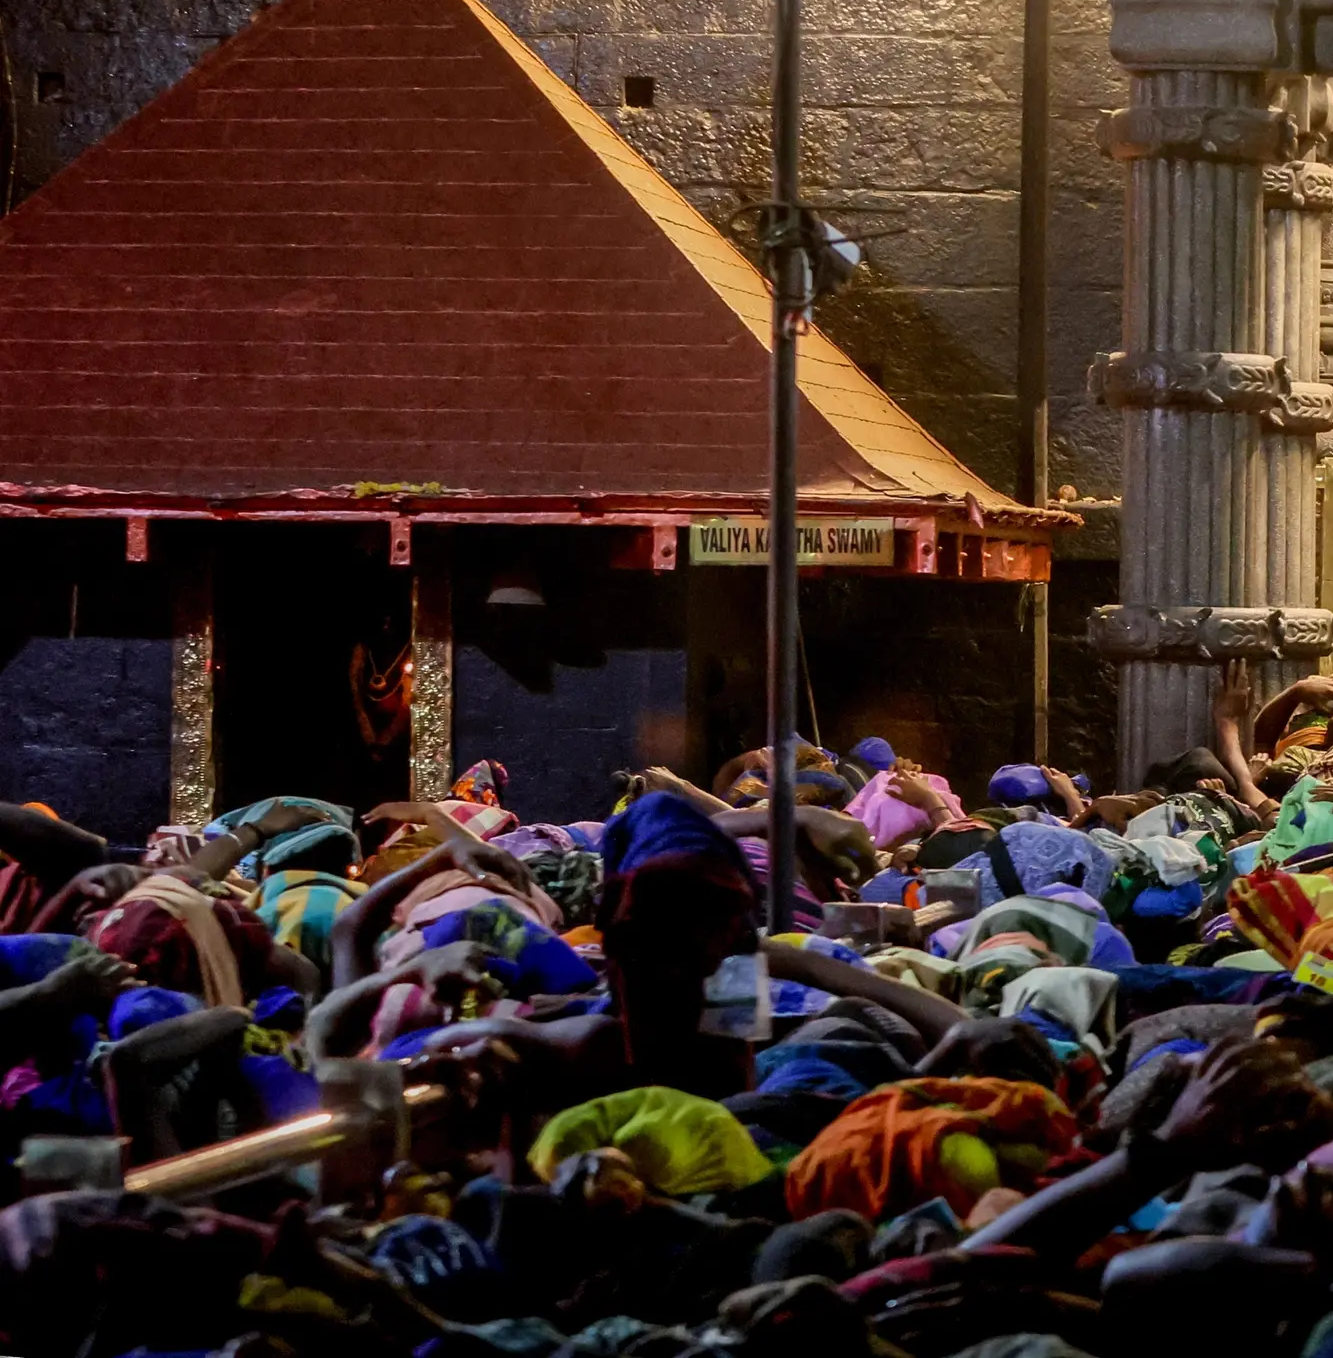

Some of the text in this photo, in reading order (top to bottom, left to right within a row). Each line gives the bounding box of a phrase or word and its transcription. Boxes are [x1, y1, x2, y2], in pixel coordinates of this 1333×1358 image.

[700, 527, 882, 553] VALIYA KATHA SWAMY
